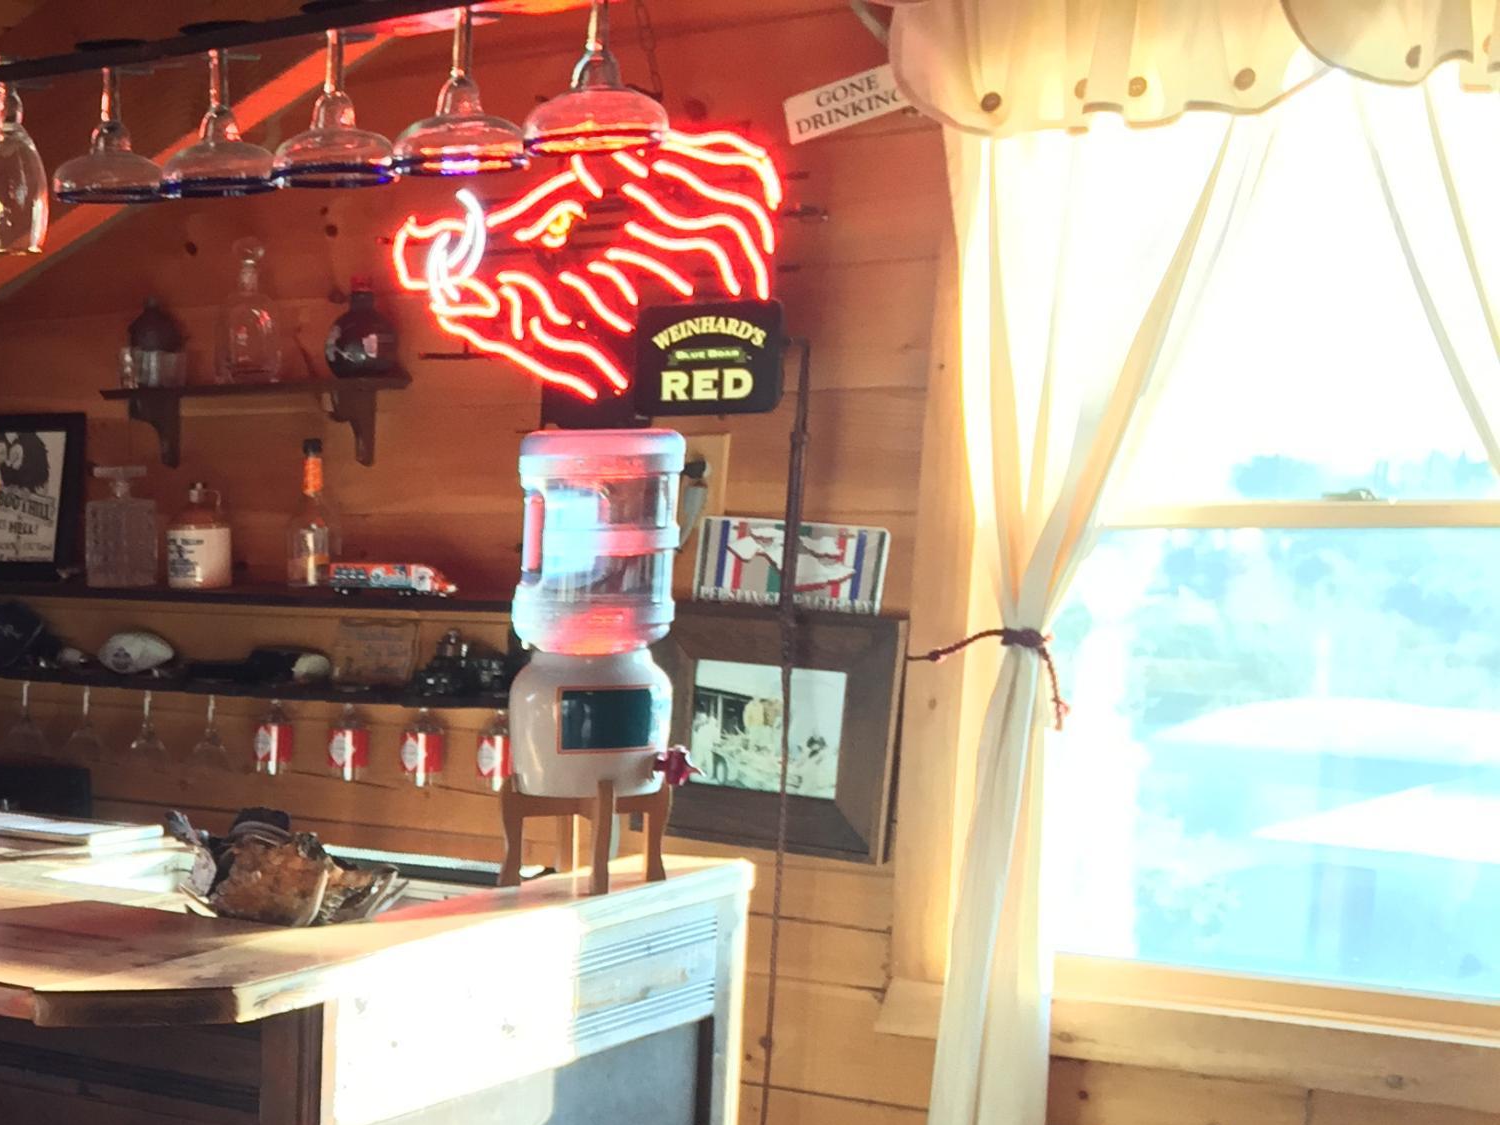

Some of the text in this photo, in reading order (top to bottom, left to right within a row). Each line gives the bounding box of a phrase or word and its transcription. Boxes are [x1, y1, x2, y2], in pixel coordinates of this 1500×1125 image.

[816, 74, 879, 107] GONE
[652, 316, 767, 350] WEINHARD'S
[661, 368, 754, 401] RED
